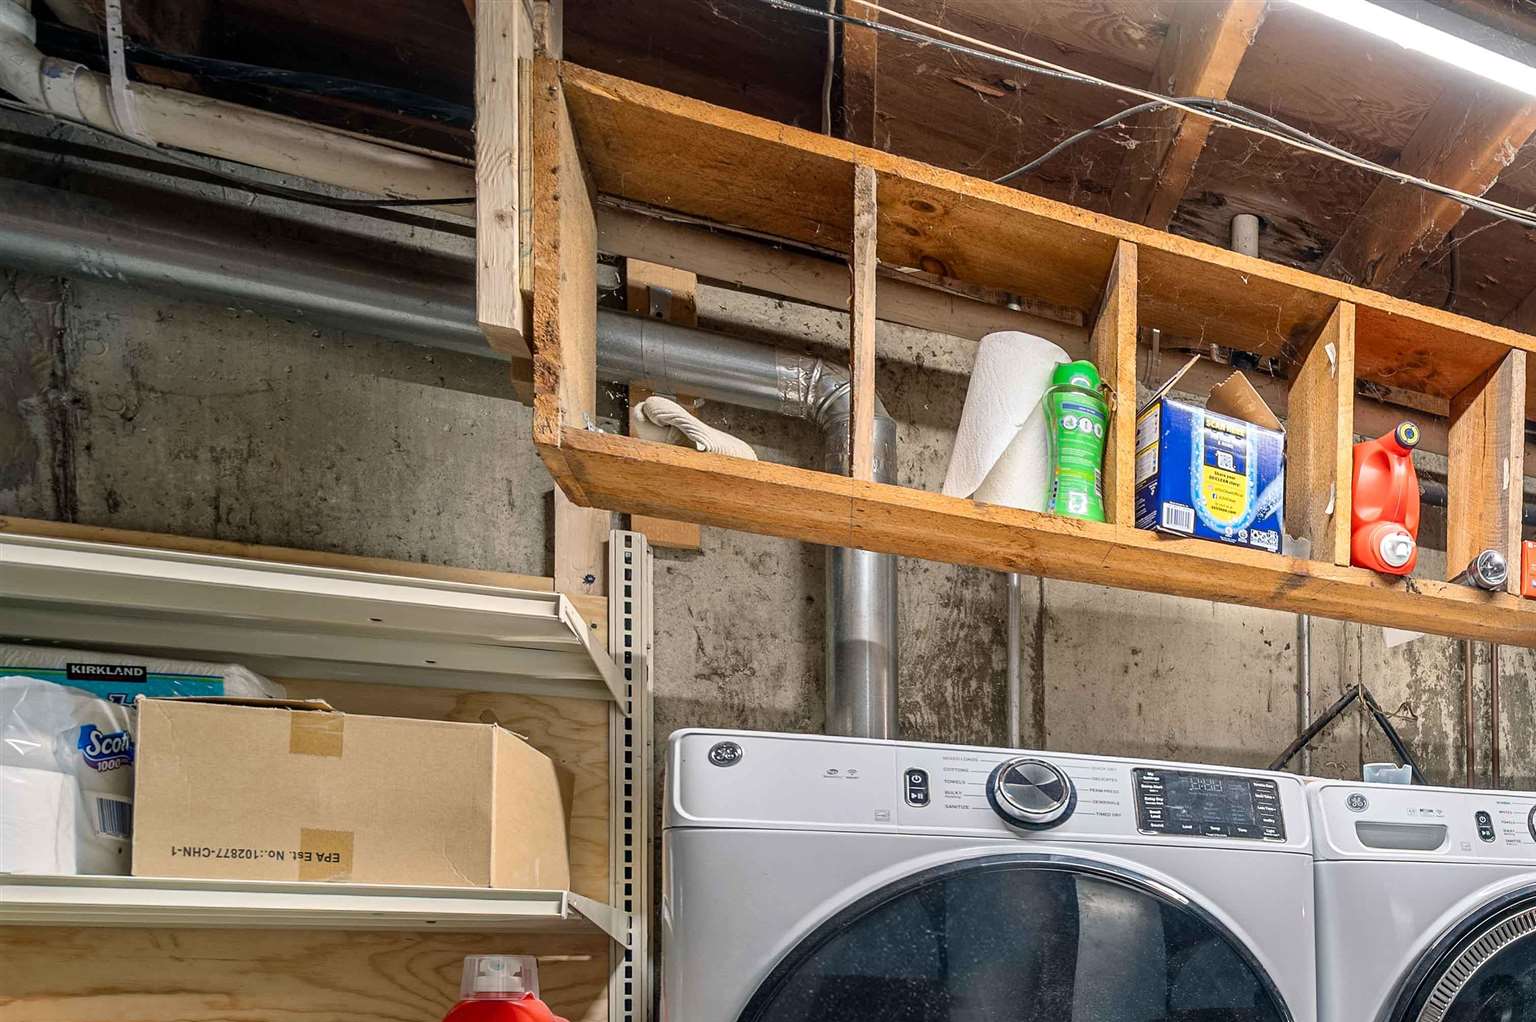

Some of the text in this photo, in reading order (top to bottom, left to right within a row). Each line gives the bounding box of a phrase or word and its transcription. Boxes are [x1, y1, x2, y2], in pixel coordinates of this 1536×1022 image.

[71, 664, 144, 677] KIRKLAND
[289, 851, 312, 862] Est.
[317, 852, 341, 863] EPA
